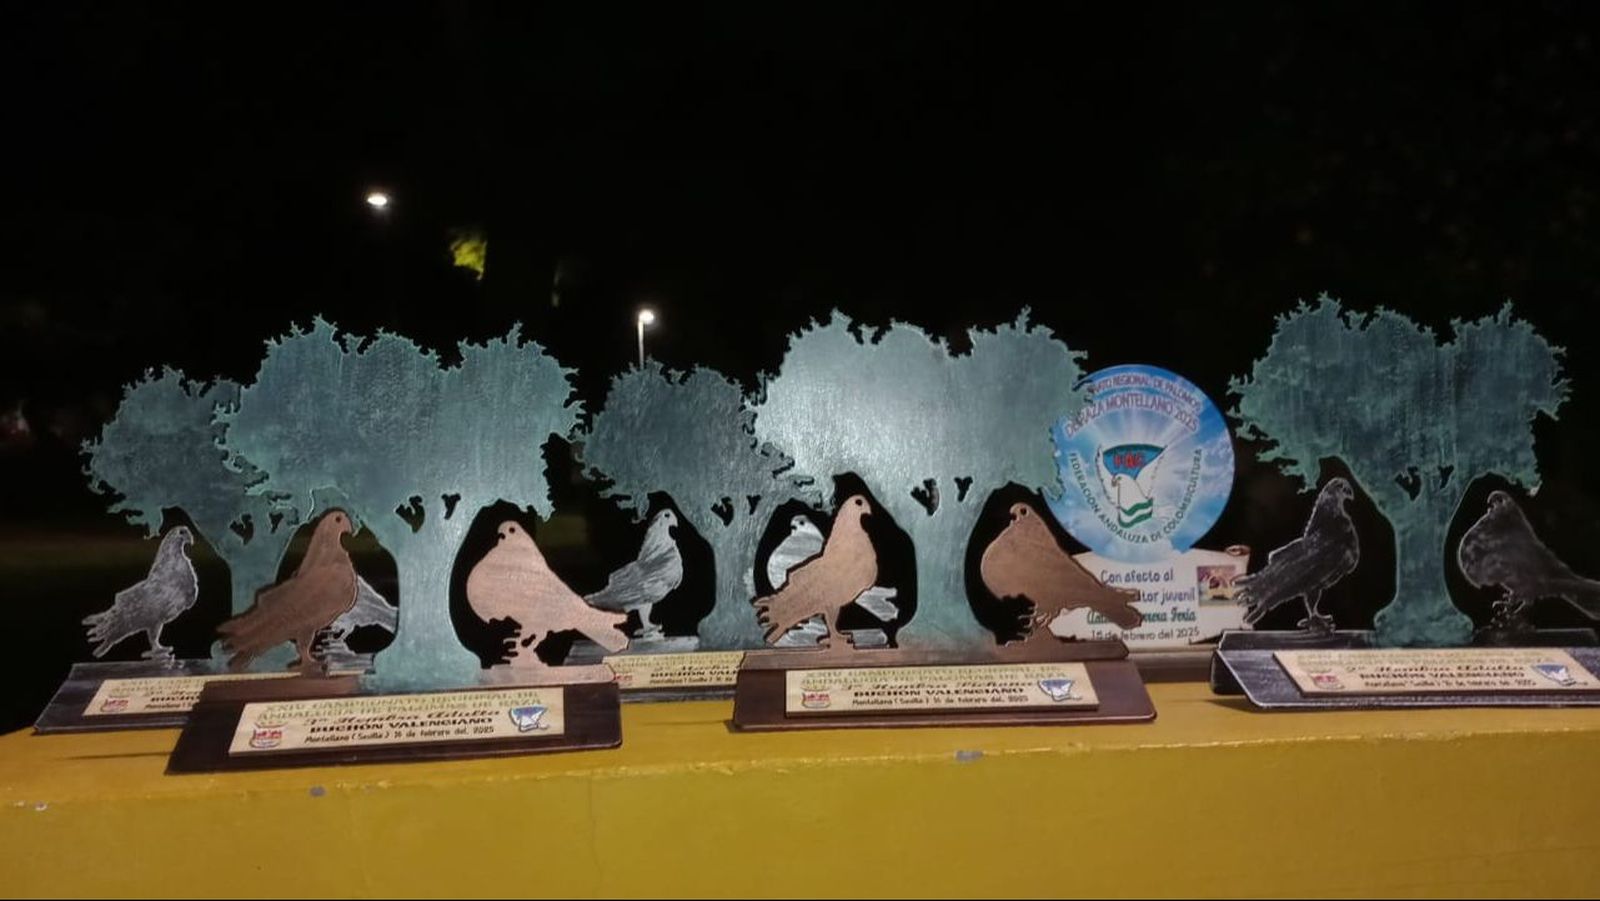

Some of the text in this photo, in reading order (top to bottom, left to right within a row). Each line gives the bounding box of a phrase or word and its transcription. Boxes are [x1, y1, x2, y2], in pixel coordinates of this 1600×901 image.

[1112, 374, 1150, 387] REGIONAL
[1105, 393, 1173, 414] MONTELLANO
[1098, 513, 1149, 544] ANDALUZA
[1151, 531, 1163, 543] DE
[1163, 449, 1202, 534] COLOMBICULTURA
[1101, 567, 1174, 584] Con afecto al
[1161, 588, 1195, 605] juvenil
[1170, 606, 1197, 622] Feria
[1157, 629, 1174, 640] del
[1175, 627, 1200, 638] 2025
[924, 686, 1025, 696] VALENCIANO
[388, 717, 493, 729] VALENCIANO
[303, 734, 350, 744] Montellano
[405, 730, 416, 738] de
[420, 728, 451, 737] febrero
[472, 726, 495, 734] 2025
